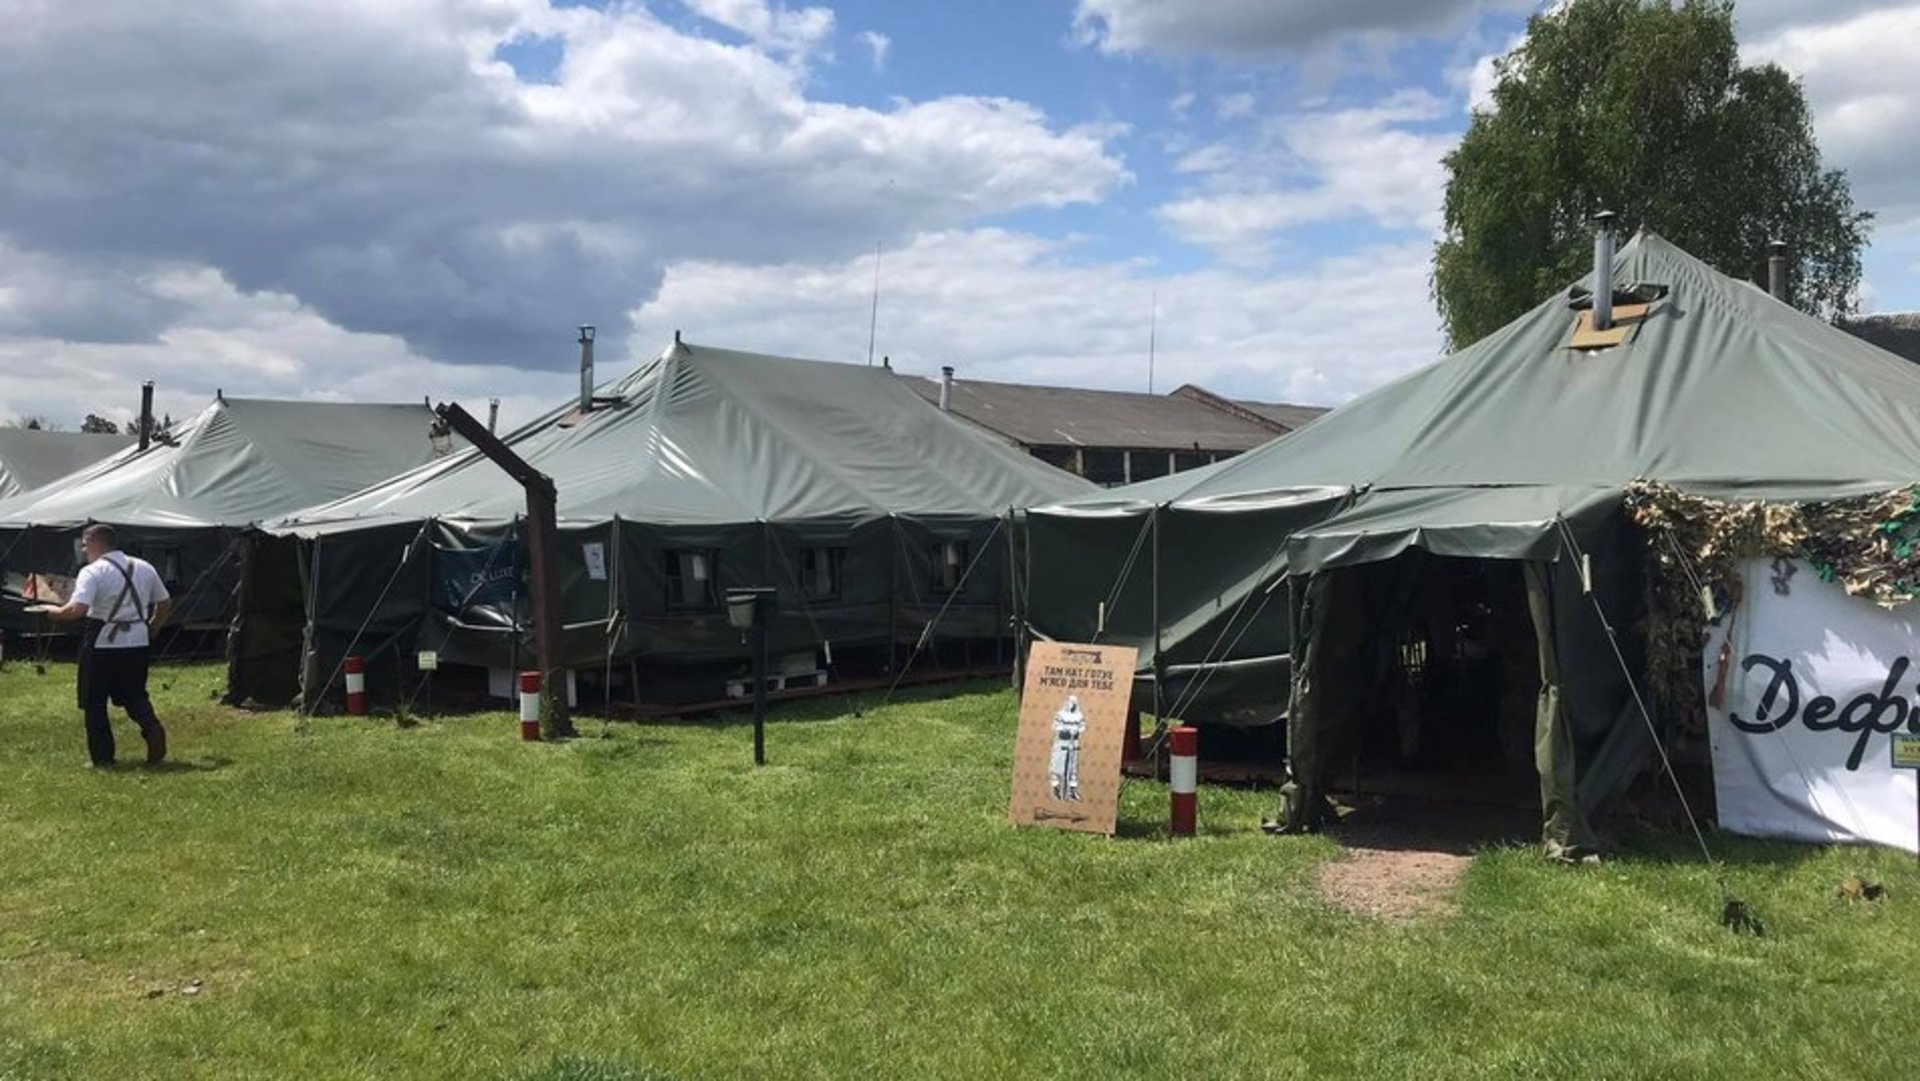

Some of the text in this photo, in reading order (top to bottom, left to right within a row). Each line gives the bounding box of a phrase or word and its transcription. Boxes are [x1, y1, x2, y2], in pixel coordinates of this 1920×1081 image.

[1044, 665, 1063, 676] ТАМ
[1068, 678, 1089, 688] ДЛЯ
[1091, 680, 1114, 690] ТЕБЕ
